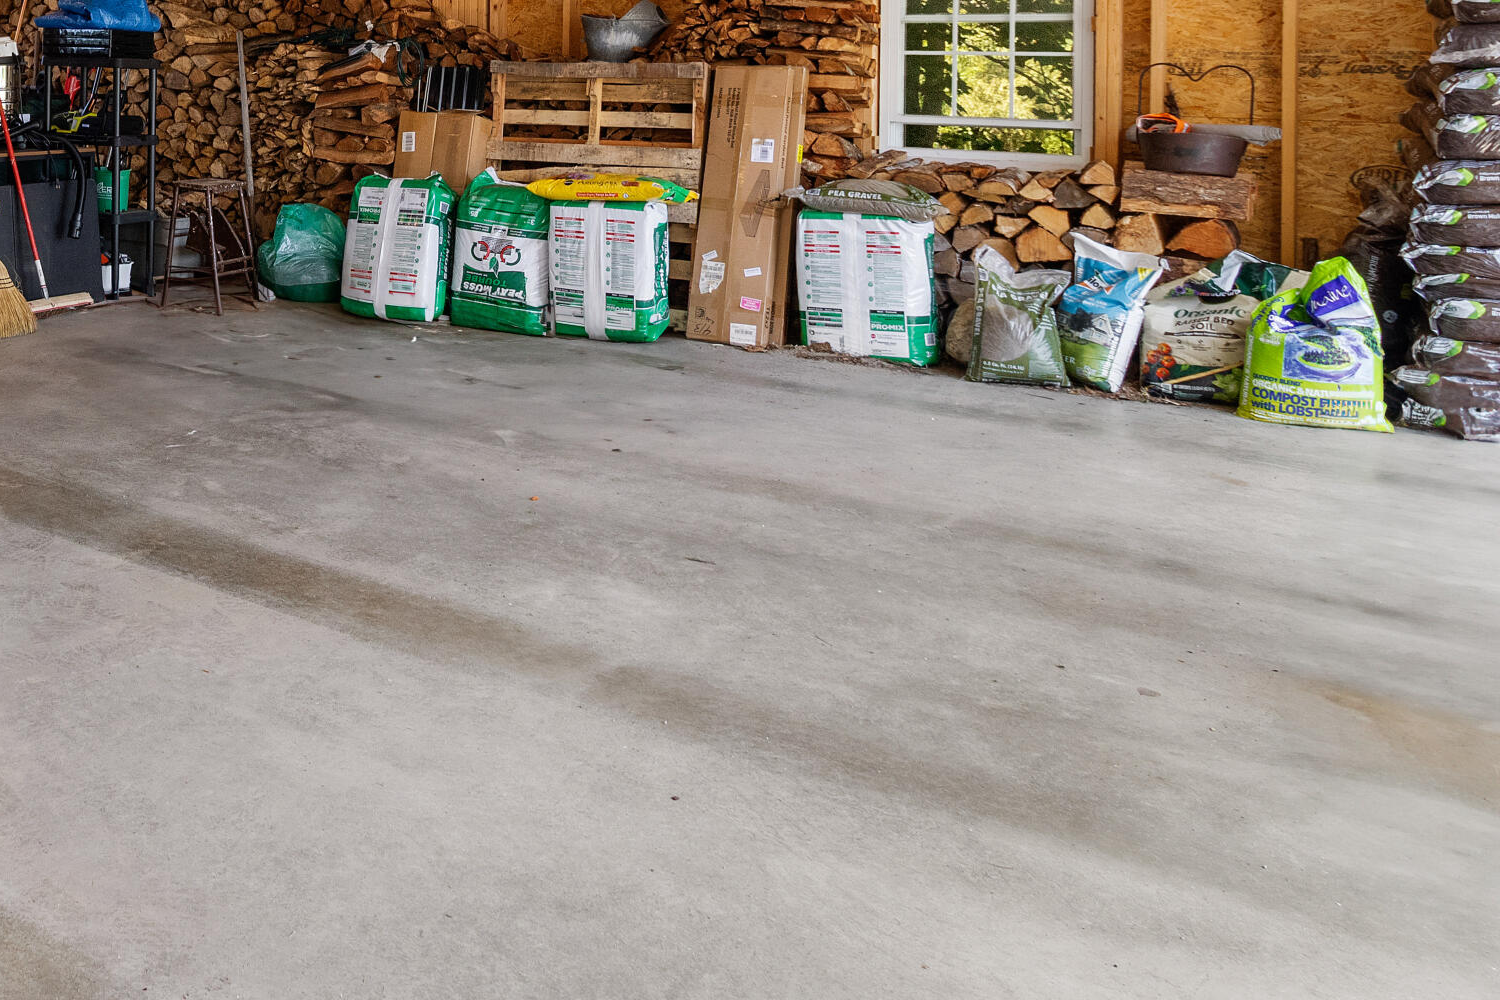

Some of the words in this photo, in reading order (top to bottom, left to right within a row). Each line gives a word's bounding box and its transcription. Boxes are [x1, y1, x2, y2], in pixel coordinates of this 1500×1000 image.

[827, 189, 846, 197] PEA
[848, 190, 882, 200] GRAVEL
[465, 274, 507, 286] TOURBE
[1311, 285, 1351, 312] Maine
[1173, 305, 1246, 319] Organic
[974, 305, 984, 336] GRAVEL
[1174, 316, 1210, 327] RAISED
[1213, 316, 1235, 326] BED
[1189, 322, 1216, 331] SOIL
[1252, 379, 1296, 394] ORGANIC
[1251, 387, 1317, 407] COMPOST
[1251, 400, 1276, 412] with
